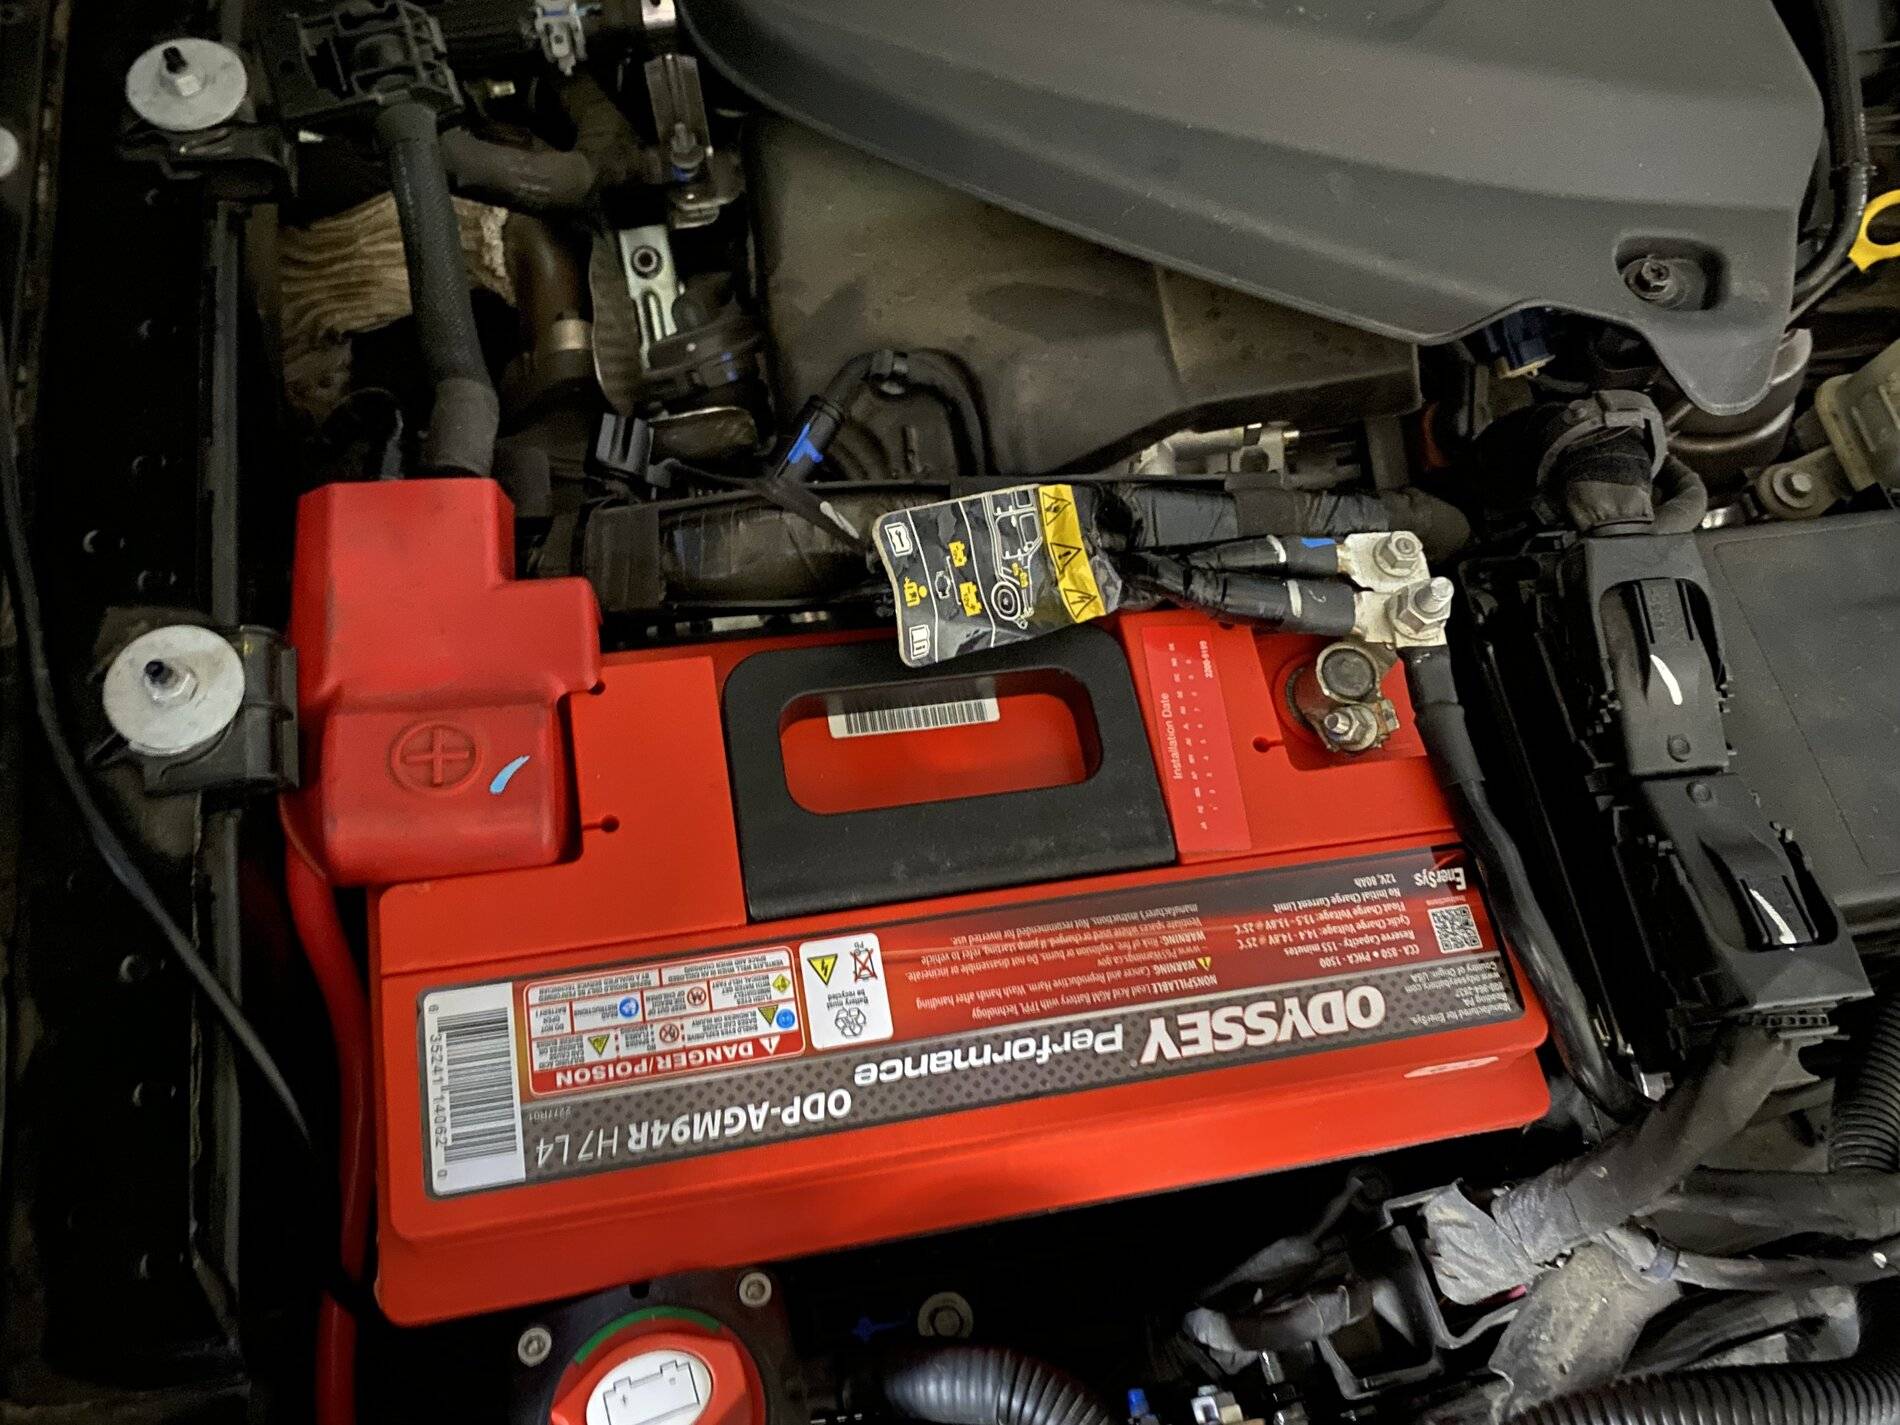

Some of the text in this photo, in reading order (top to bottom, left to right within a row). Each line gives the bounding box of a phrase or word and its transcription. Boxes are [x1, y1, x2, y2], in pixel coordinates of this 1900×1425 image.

[1161, 693, 1173, 717] Date
[1165, 721, 1183, 779] Installation
[1352, 873, 1377, 888] 80Ah
[1410, 862, 1469, 896] EnerSys
[1271, 885, 1401, 915] No Initial Charge Current Limit
[1380, 898, 1406, 913] Float
[1138, 901, 1198, 920] manufacturer's
[1314, 906, 1352, 923] Voltage:
[1350, 901, 1382, 918] Charge
[1073, 917, 1090, 929] Not
[1165, 914, 1202, 931] Ventilate
[1263, 915, 1290, 931] 13.8V
[1294, 912, 1315, 926] 13.5
[1354, 915, 1387, 932] Charge
[1384, 912, 1410, 927] Cyclic
[1002, 927, 1015, 939] for
[1015, 918, 1073, 937] recommended
[1091, 927, 1111, 939] used
[1111, 923, 1139, 939] where
[1138, 919, 1166, 935] spaces
[1232, 921, 1255, 936] 25°C
[1297, 926, 1318, 940] 14.4
[1317, 920, 1356, 937] Voltage:
[967, 929, 1002, 944] inverted
[1016, 936, 1039, 950] jump
[1081, 930, 1093, 941] or
[1141, 934, 1159, 948] Risk
[1157, 927, 1205, 946] WARNING:
[1235, 935, 1258, 950] 25°C
[1266, 930, 1293, 945] 14.8V
[1282, 927, 1415, 959] Reserve Capacity 155 minutes
[853, 941, 864, 949] Pb
[1074, 939, 1114, 957] explosion
[1130, 937, 1142, 950] of
[920, 951, 949, 965] vehicle
[950, 949, 960, 960] to
[960, 946, 981, 959] refer
[1010, 953, 1025, 966] not
[1025, 952, 1038, 964] Do
[1065, 946, 1075, 958] or
[1317, 943, 1420, 969] CCA 850 PHCA 1500
[948, 963, 958, 975] or
[958, 955, 1010, 974] disassemble
[1454, 963, 1466, 975] of
[1465, 958, 1496, 974] Country
[1051, 969, 1105, 990] Reproductive
[1105, 968, 1122, 983] and
[1121, 964, 1151, 981] Cancer
[1409, 969, 1429, 983] USA
[1001, 982, 1025, 997] Wash
[1025, 978, 1052, 994] Harm.
[1129, 982, 1151, 996] Lead
[1150, 972, 1217, 994] NONSPILLABLE
[826, 987, 865, 1001] be recycled
[954, 990, 975, 1004] after
[975, 986, 1001, 1001] hands
[1059, 990, 1090, 1007] Battery
[1090, 988, 1112, 1002] AGM
[1111, 985, 1130, 999] Acid
[825, 995, 868, 1010] Battery must
[914, 991, 954, 1010] handling
[1039, 996, 1059, 1010] with
[970, 1000, 1017, 1020] Technology
[1445, 1008, 1458, 1021] for
[1457, 1000, 1511, 1019] Manufactured
[1130, 982, 1391, 1064] ODYSSEY
[430, 1032, 443, 1082] 35241
[554, 1041, 753, 1088] DANGER/POISON
[852, 1021, 1127, 1093] Performance
[527, 1106, 571, 1120] 2277R01
[433, 1094, 447, 1148] 14062
[534, 1086, 854, 1168] ODP-AGM94R H7 L4
[437, 1168, 447, 1179] 0
